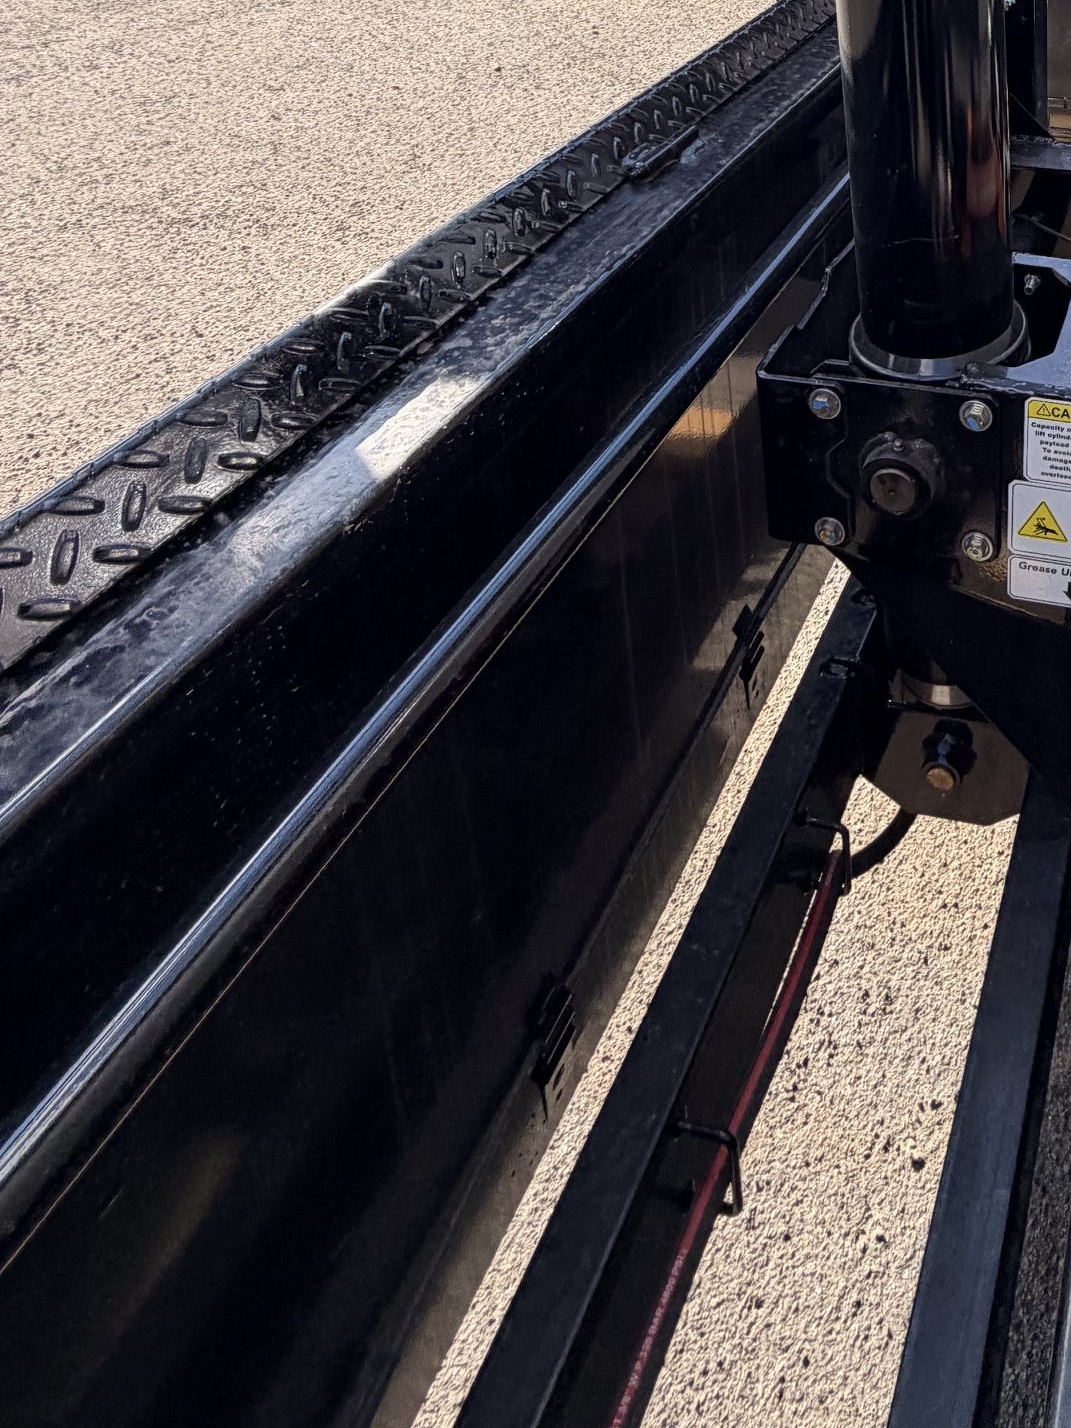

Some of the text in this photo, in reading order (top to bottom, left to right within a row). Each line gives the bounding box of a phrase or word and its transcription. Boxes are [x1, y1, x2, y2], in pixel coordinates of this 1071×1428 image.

[1031, 421, 1065, 433] Capacity
[1034, 430, 1046, 438] lift
[1039, 439, 1070, 449] payload
[1018, 561, 1058, 575] Grease
